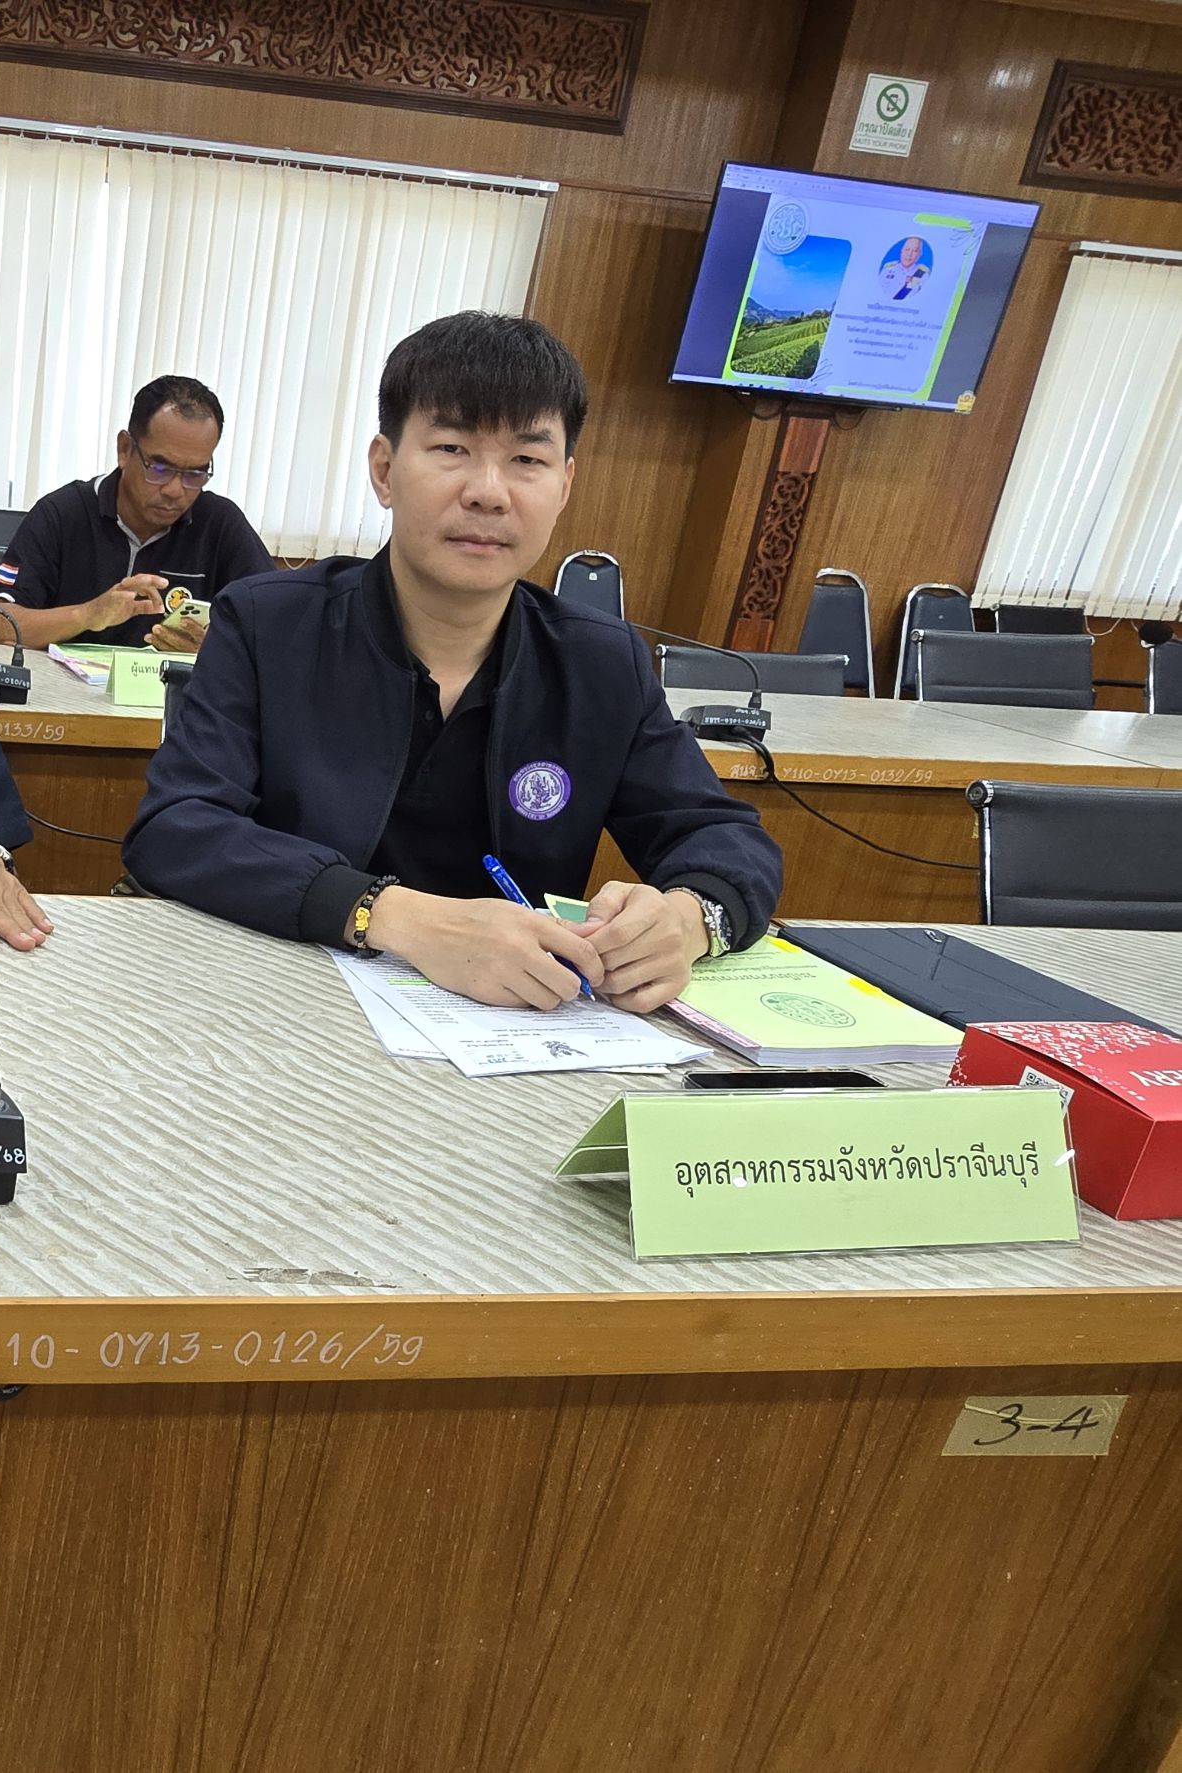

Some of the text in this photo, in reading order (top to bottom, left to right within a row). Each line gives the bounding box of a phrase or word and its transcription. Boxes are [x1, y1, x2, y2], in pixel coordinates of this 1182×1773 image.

[675, 1141, 1040, 1198] อุตสาหกรรมจังหวัดปราจีนบุรี
[973, 1403, 1099, 1446] 3-4
